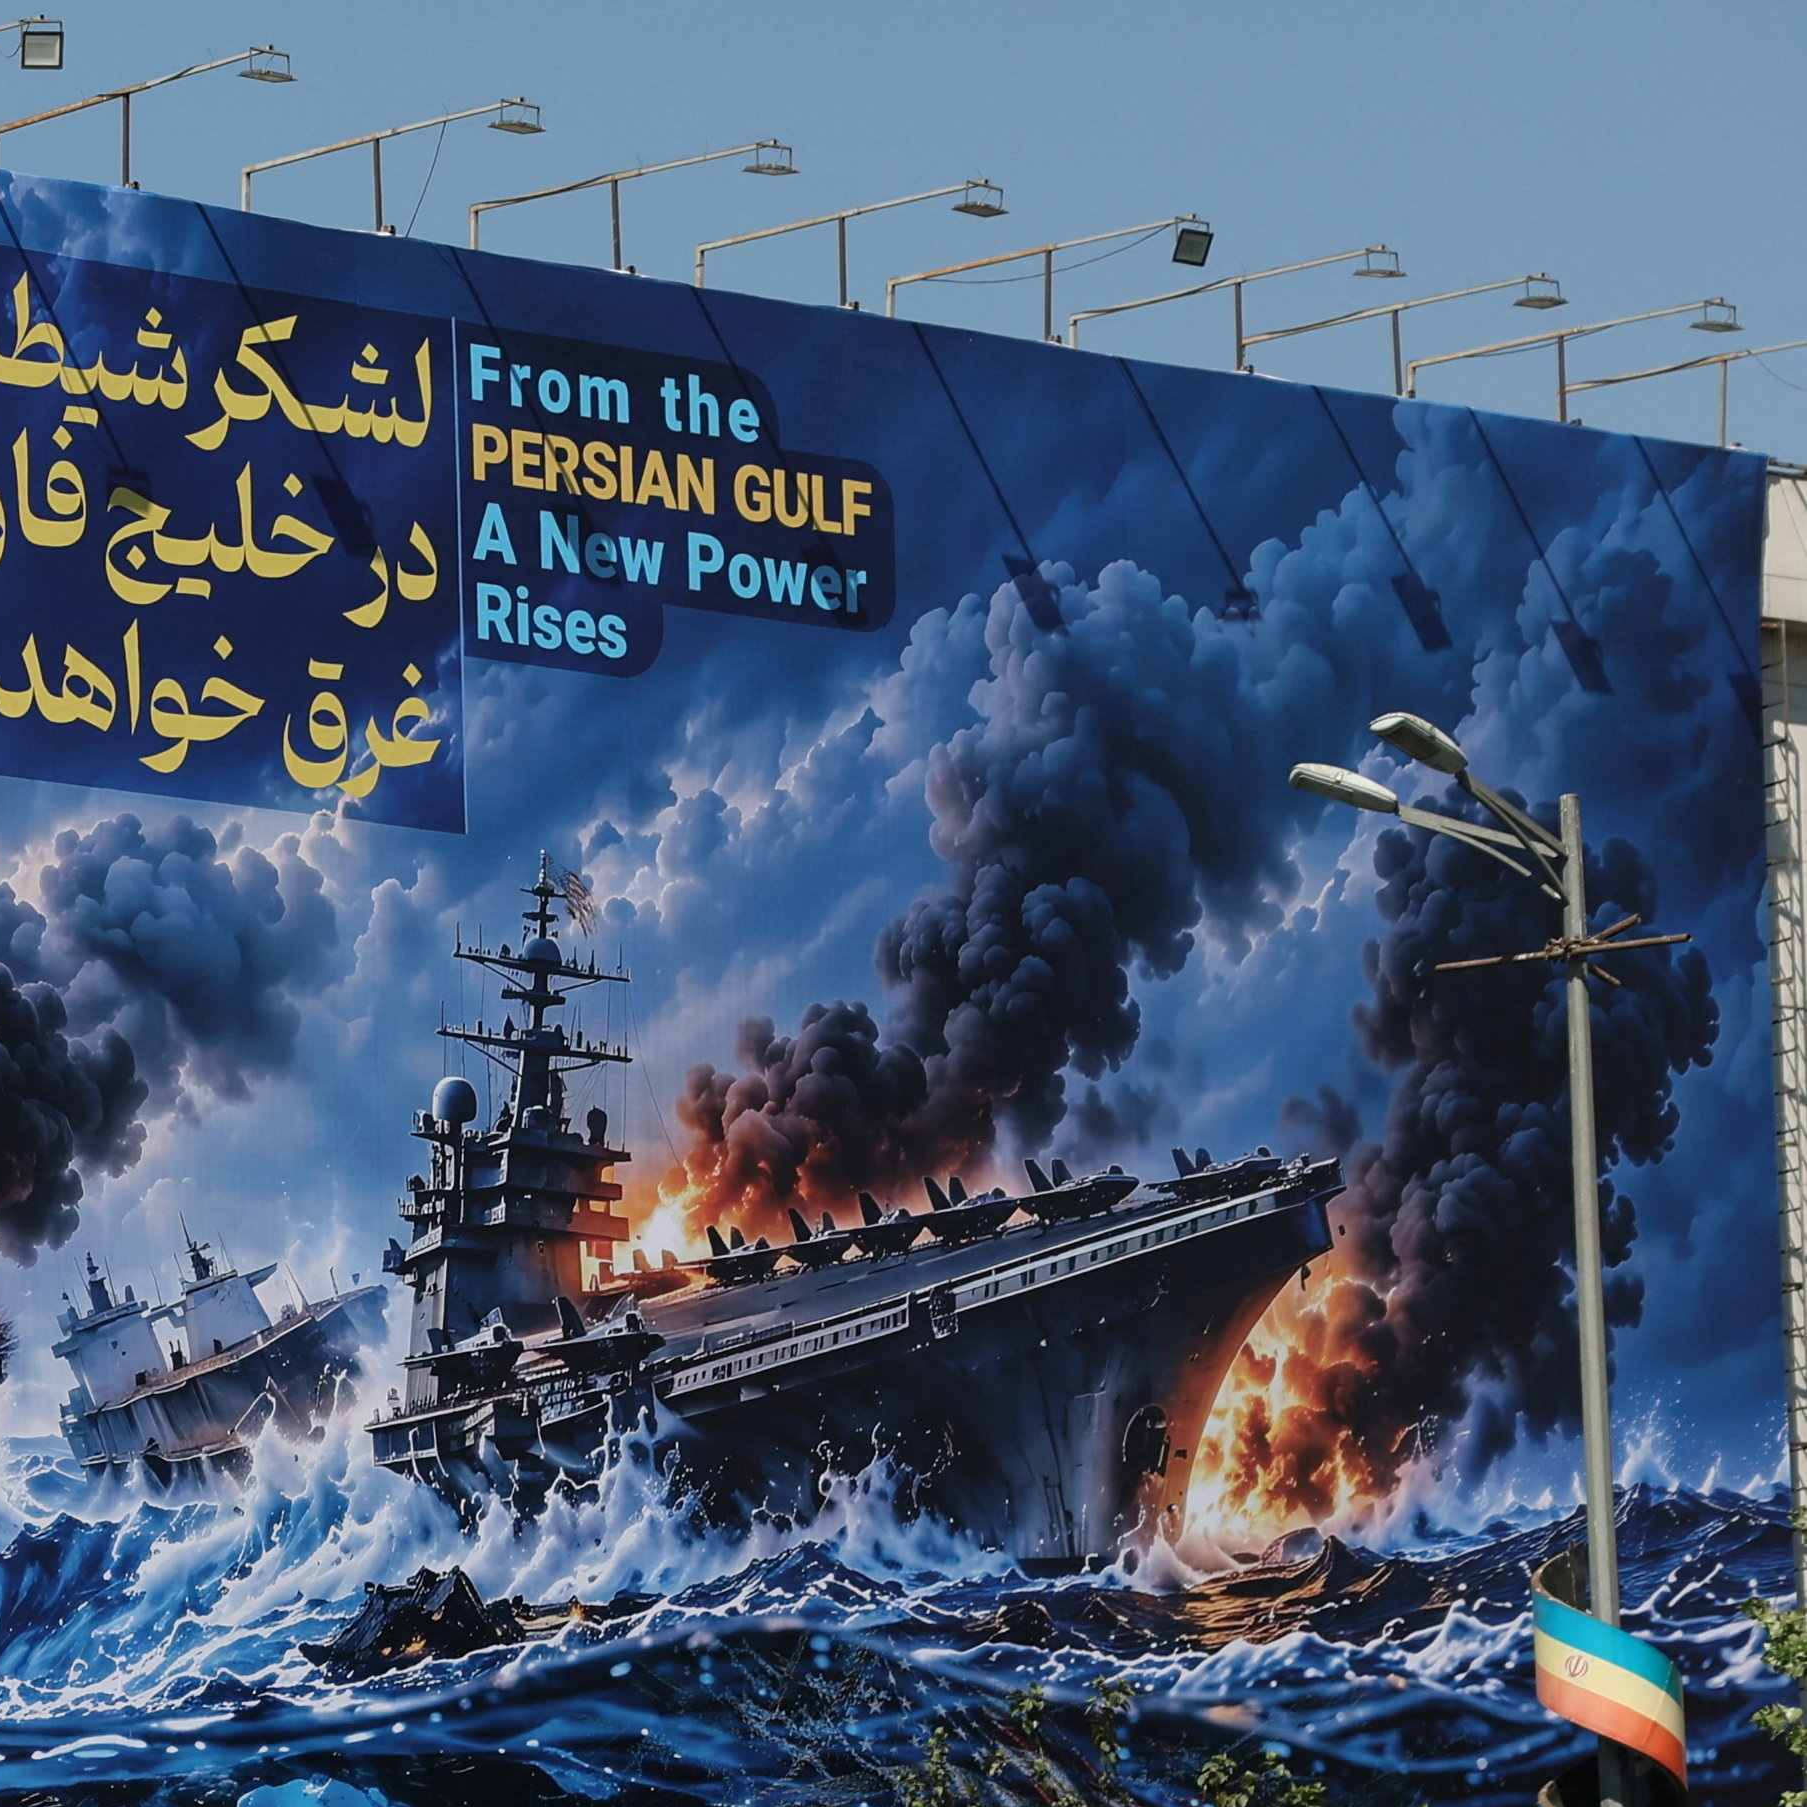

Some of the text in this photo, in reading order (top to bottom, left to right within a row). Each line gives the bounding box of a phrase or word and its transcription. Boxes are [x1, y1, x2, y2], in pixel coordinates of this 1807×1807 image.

[184, 313, 434, 450] لشکر
[468, 344, 761, 446] From the
[102, 460, 334, 606] خلیج
[471, 424, 874, 538] PERSIAN GULF
[340, 516, 439, 630] در
[471, 503, 868, 617] A New Power
[475, 583, 629, 661] Rises
[280, 655, 442, 799] غرق
